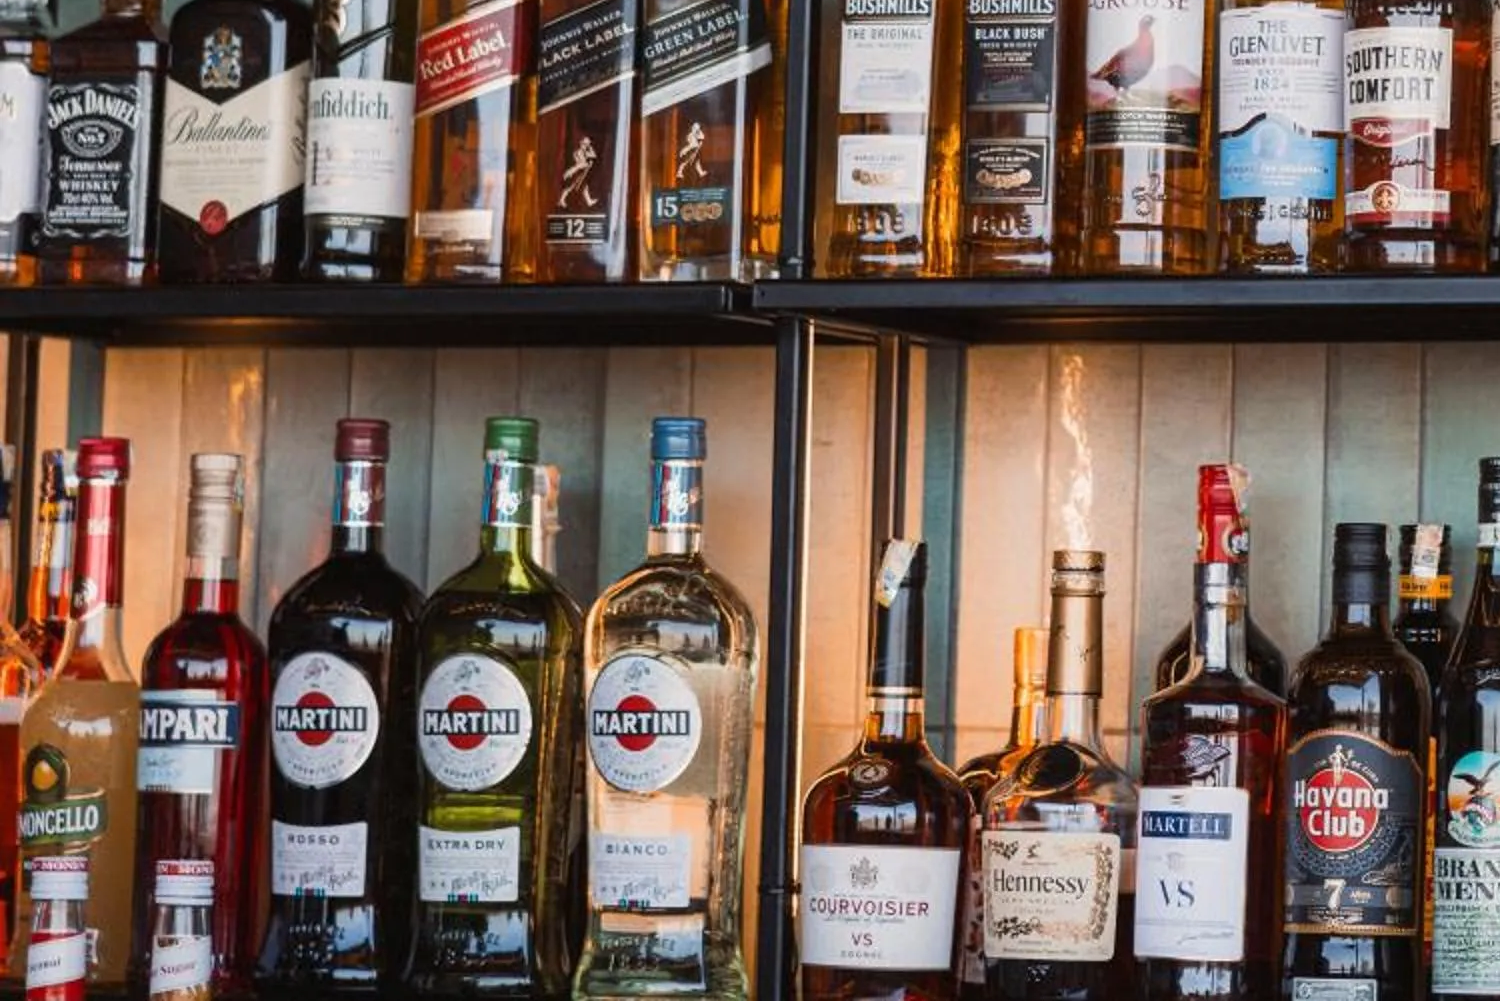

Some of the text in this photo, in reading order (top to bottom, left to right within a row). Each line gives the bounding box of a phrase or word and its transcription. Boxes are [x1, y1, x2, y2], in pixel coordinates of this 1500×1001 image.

[645, 10, 746, 59] GREEN LABEL
[1257, 20, 1288, 34] THE
[421, 50, 455, 80] Red
[456, 30, 506, 63] Label
[540, 44, 581, 68] LACK
[585, 22, 636, 48] LABEL
[1230, 35, 1325, 57] GLENLIVET
[1346, 46, 1443, 76] SOUTHERN
[1349, 76, 1434, 104] COMFORT
[59, 180, 120, 192] WHISKEY
[656, 196, 679, 218] 15
[565, 218, 585, 238] 12
[277, 709, 366, 730] MARTINI
[424, 711, 519, 734] MARTINI
[595, 712, 688, 734] MARTINI
[1294, 780, 1389, 809] Havana
[1308, 810, 1365, 838] Club
[287, 834, 340, 846] ROSSO
[428, 839, 505, 851] EXTRA DRY
[605, 843, 669, 856] BIANCO
[993, 868, 1090, 901] Hennessy
[1158, 879, 1196, 908] VS
[1324, 878, 1347, 910] 7
[809, 896, 930, 917] COURVOISIER
[851, 933, 874, 947] VS
